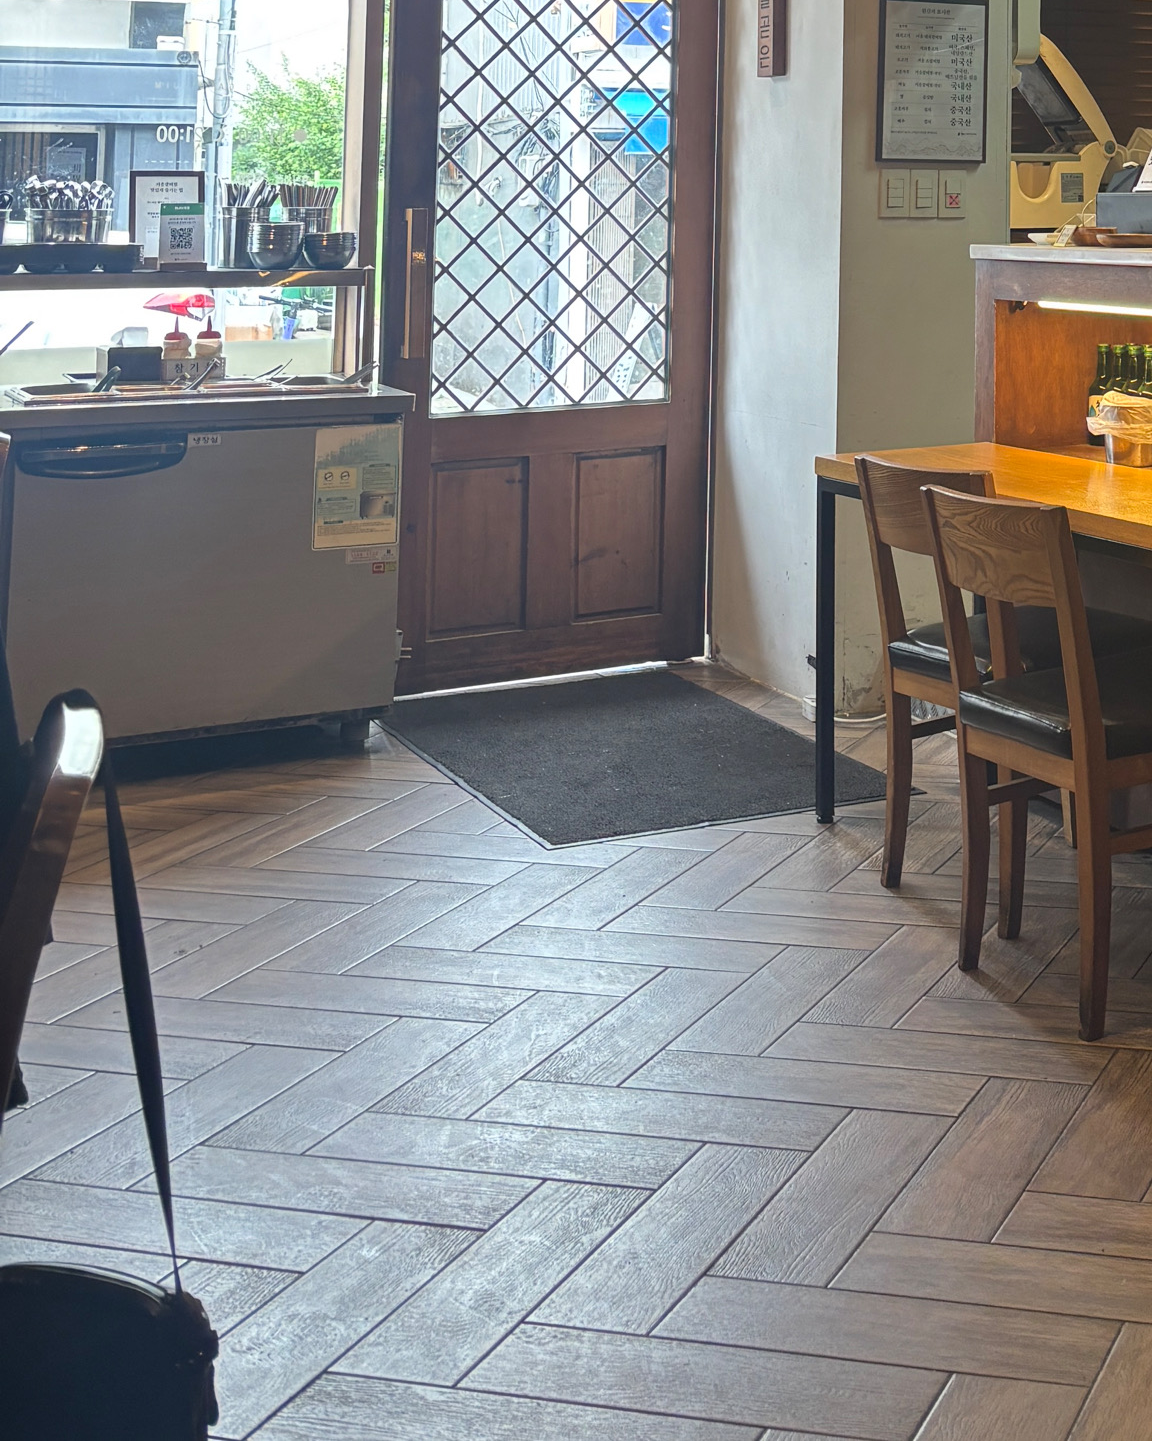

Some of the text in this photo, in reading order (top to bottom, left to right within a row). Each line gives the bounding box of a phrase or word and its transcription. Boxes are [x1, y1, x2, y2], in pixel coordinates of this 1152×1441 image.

[951, 33, 973, 43] 미국산
[951, 58, 973, 67] 미국산
[950, 82, 972, 91] 국내산
[950, 94, 972, 103] 국내산
[950, 106, 972, 116] 중국산
[950, 118, 972, 127] 중국산
